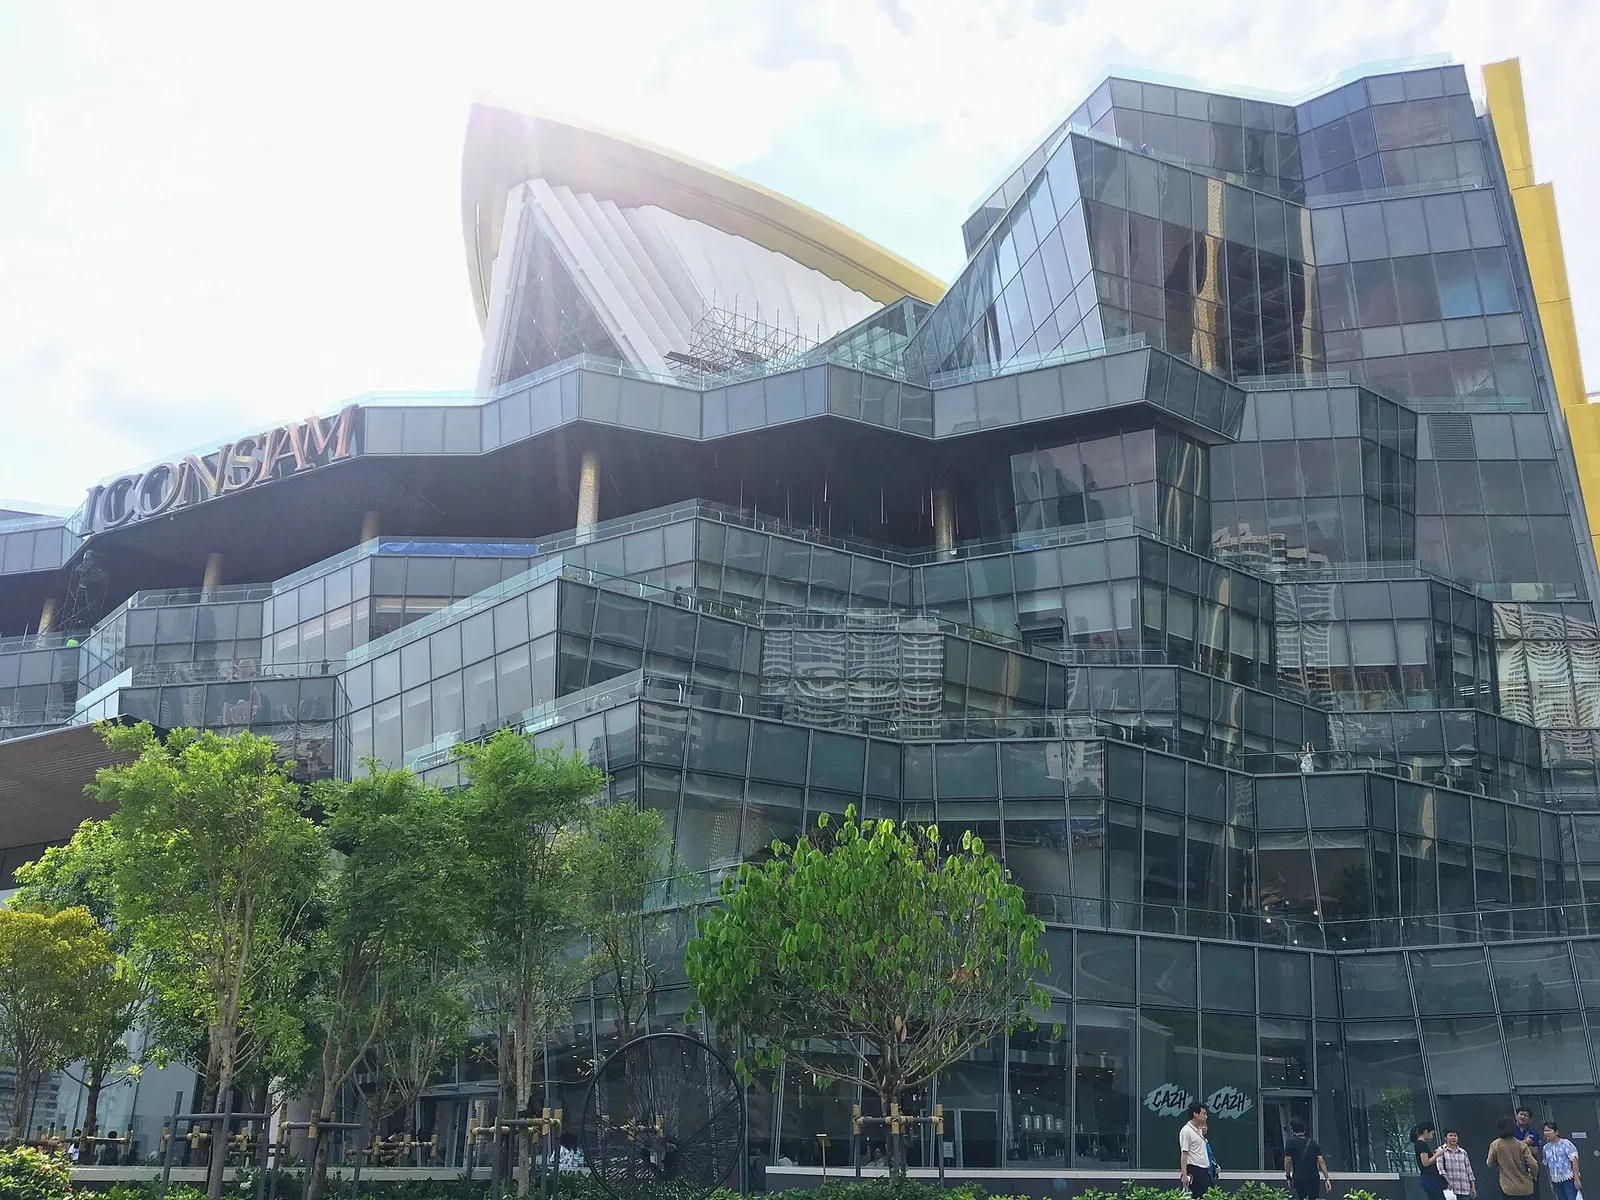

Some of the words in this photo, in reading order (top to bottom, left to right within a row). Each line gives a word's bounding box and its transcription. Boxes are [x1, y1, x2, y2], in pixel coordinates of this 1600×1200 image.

[80, 403, 359, 537] ICONSIAM
[1151, 1090, 1188, 1110] CAZH
[1211, 1093, 1246, 1112] CAZH
